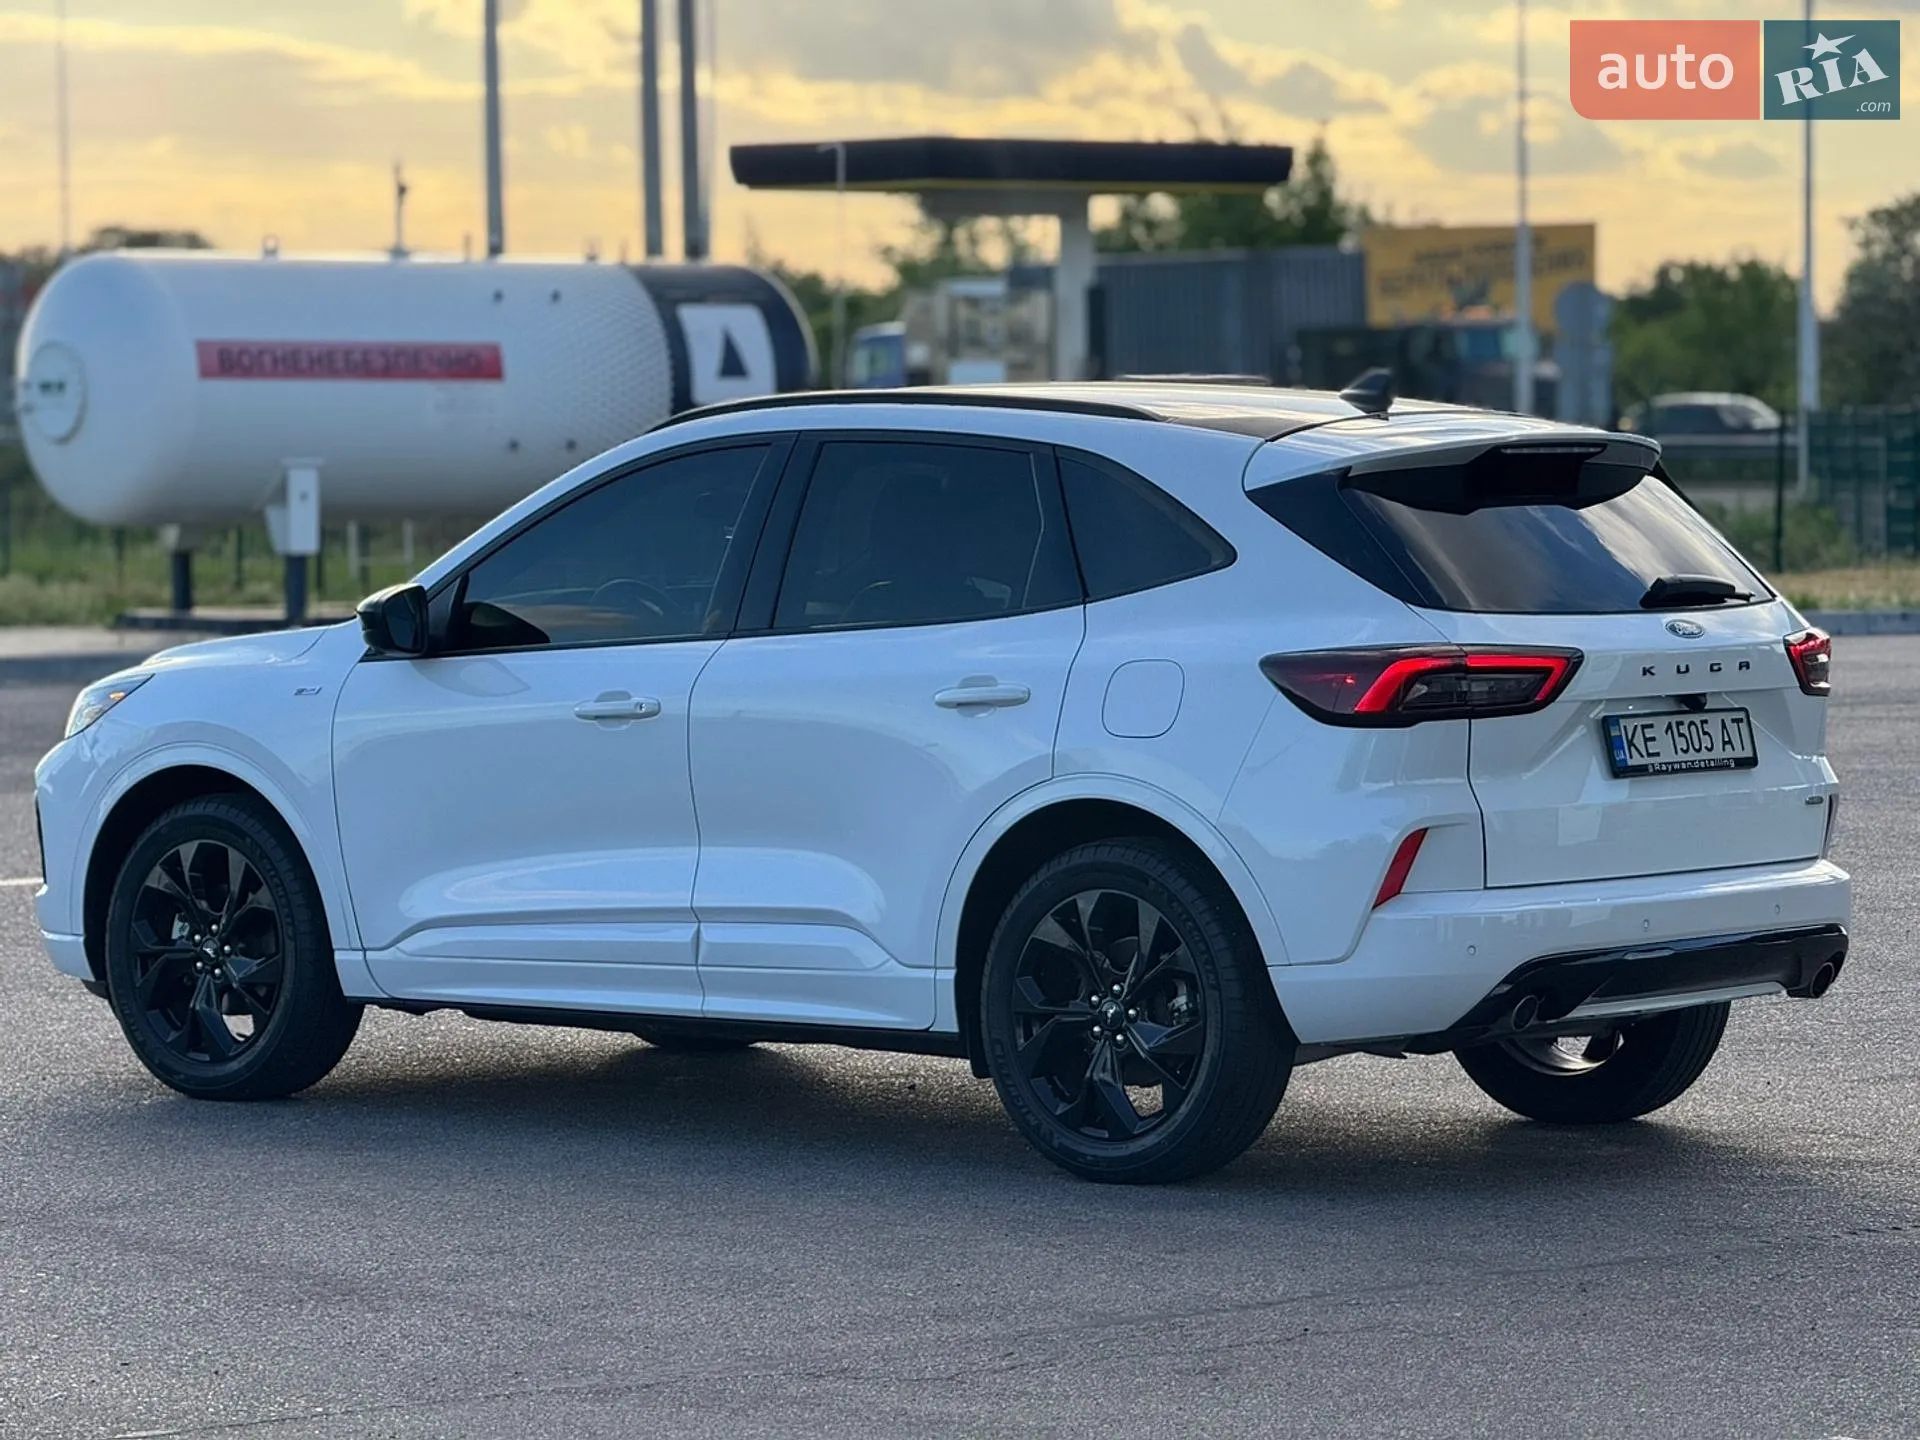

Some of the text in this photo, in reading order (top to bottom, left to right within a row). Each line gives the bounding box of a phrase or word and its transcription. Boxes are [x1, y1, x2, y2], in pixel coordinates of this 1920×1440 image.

[216, 346, 484, 376] ВОГНЕНЕБЕЗПЕЧНО
[1642, 660, 1751, 677] KUGA
[1623, 717, 1746, 760] KE 1505 AT
